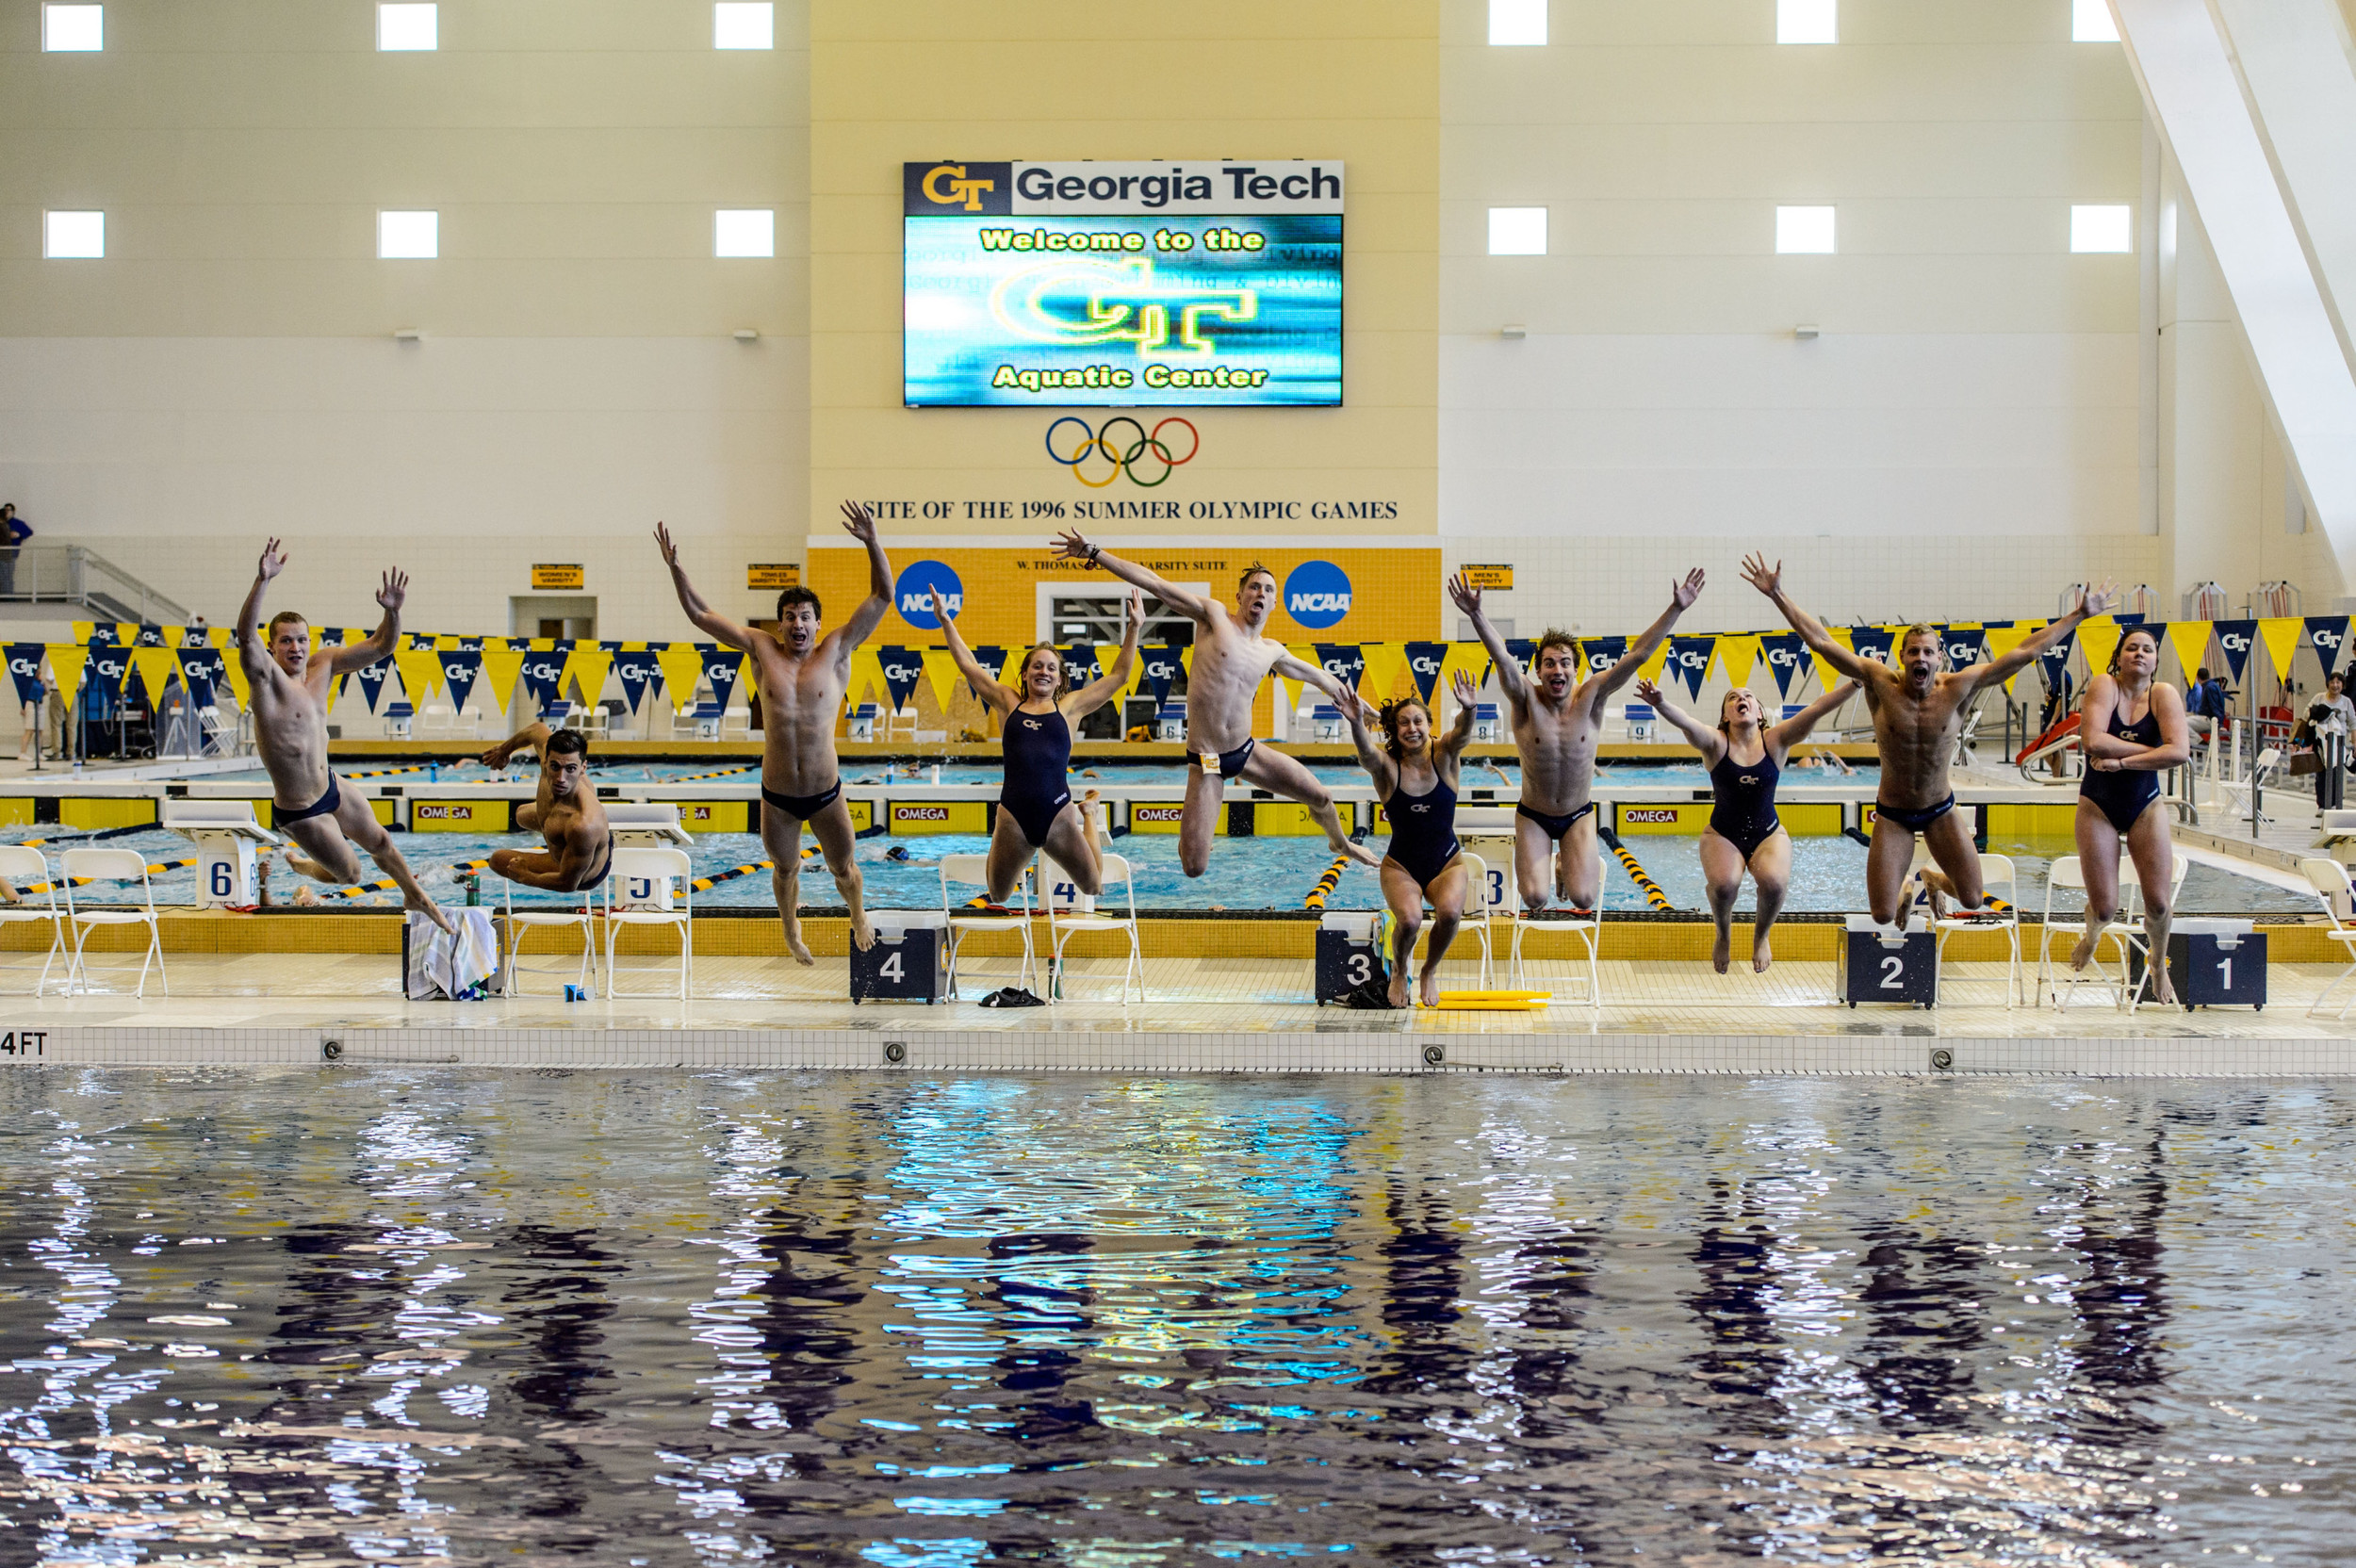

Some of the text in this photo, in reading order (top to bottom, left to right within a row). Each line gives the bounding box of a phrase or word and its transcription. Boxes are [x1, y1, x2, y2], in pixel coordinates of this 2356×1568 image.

[923, 166, 993, 211] GT
[1017, 167, 1340, 207] Georgia Tech
[979, 227, 1266, 252] Welcome to the
[991, 257, 1258, 361] GT
[991, 364, 1269, 392] Aquatic Center
[862, 500, 1398, 519] SITE OF THE 1996 SUMMER OLYMPIC GAMES
[1017, 561, 1030, 571] W.
[1035, 561, 1085, 571] THOMAS
[1139, 561, 1188, 571] VARSITY
[1192, 561, 1228, 571] SUITE
[1290, 593, 1351, 612] NCAA
[2221, 632, 2250, 652] GT
[2313, 629, 2342, 648] GT
[1679, 650, 1708, 669] GT
[1768, 648, 1796, 667] GT
[1949, 643, 1977, 661] GT
[10, 659, 38, 677] GT
[97, 660, 124, 678] GT
[185, 662, 212, 679] GT
[446, 663, 472, 682] GT
[532, 663, 561, 681] GT
[621, 663, 648, 682] GT
[709, 664, 736, 682] GT
[885, 664, 912, 682] GT
[1147, 662, 1175, 679] GT
[1323, 659, 1351, 678] GT
[1413, 656, 1440, 675] GT
[1166, 726, 1175, 739] 6
[1323, 726, 1332, 740] 7
[1479, 727, 1487, 740] 8
[1635, 727, 1644, 741] 9
[897, 808, 946, 820] OMEGA
[1626, 810, 1675, 822] OMEGA
[211, 861, 232, 896] 6
[1481, 870, 1503, 906] 3
[1053, 882, 1076, 903] 4
[879, 952, 906, 984] 4
[1347, 954, 1372, 987] 3
[1879, 956, 1904, 988] 2
[2217, 957, 2232, 989] 1
